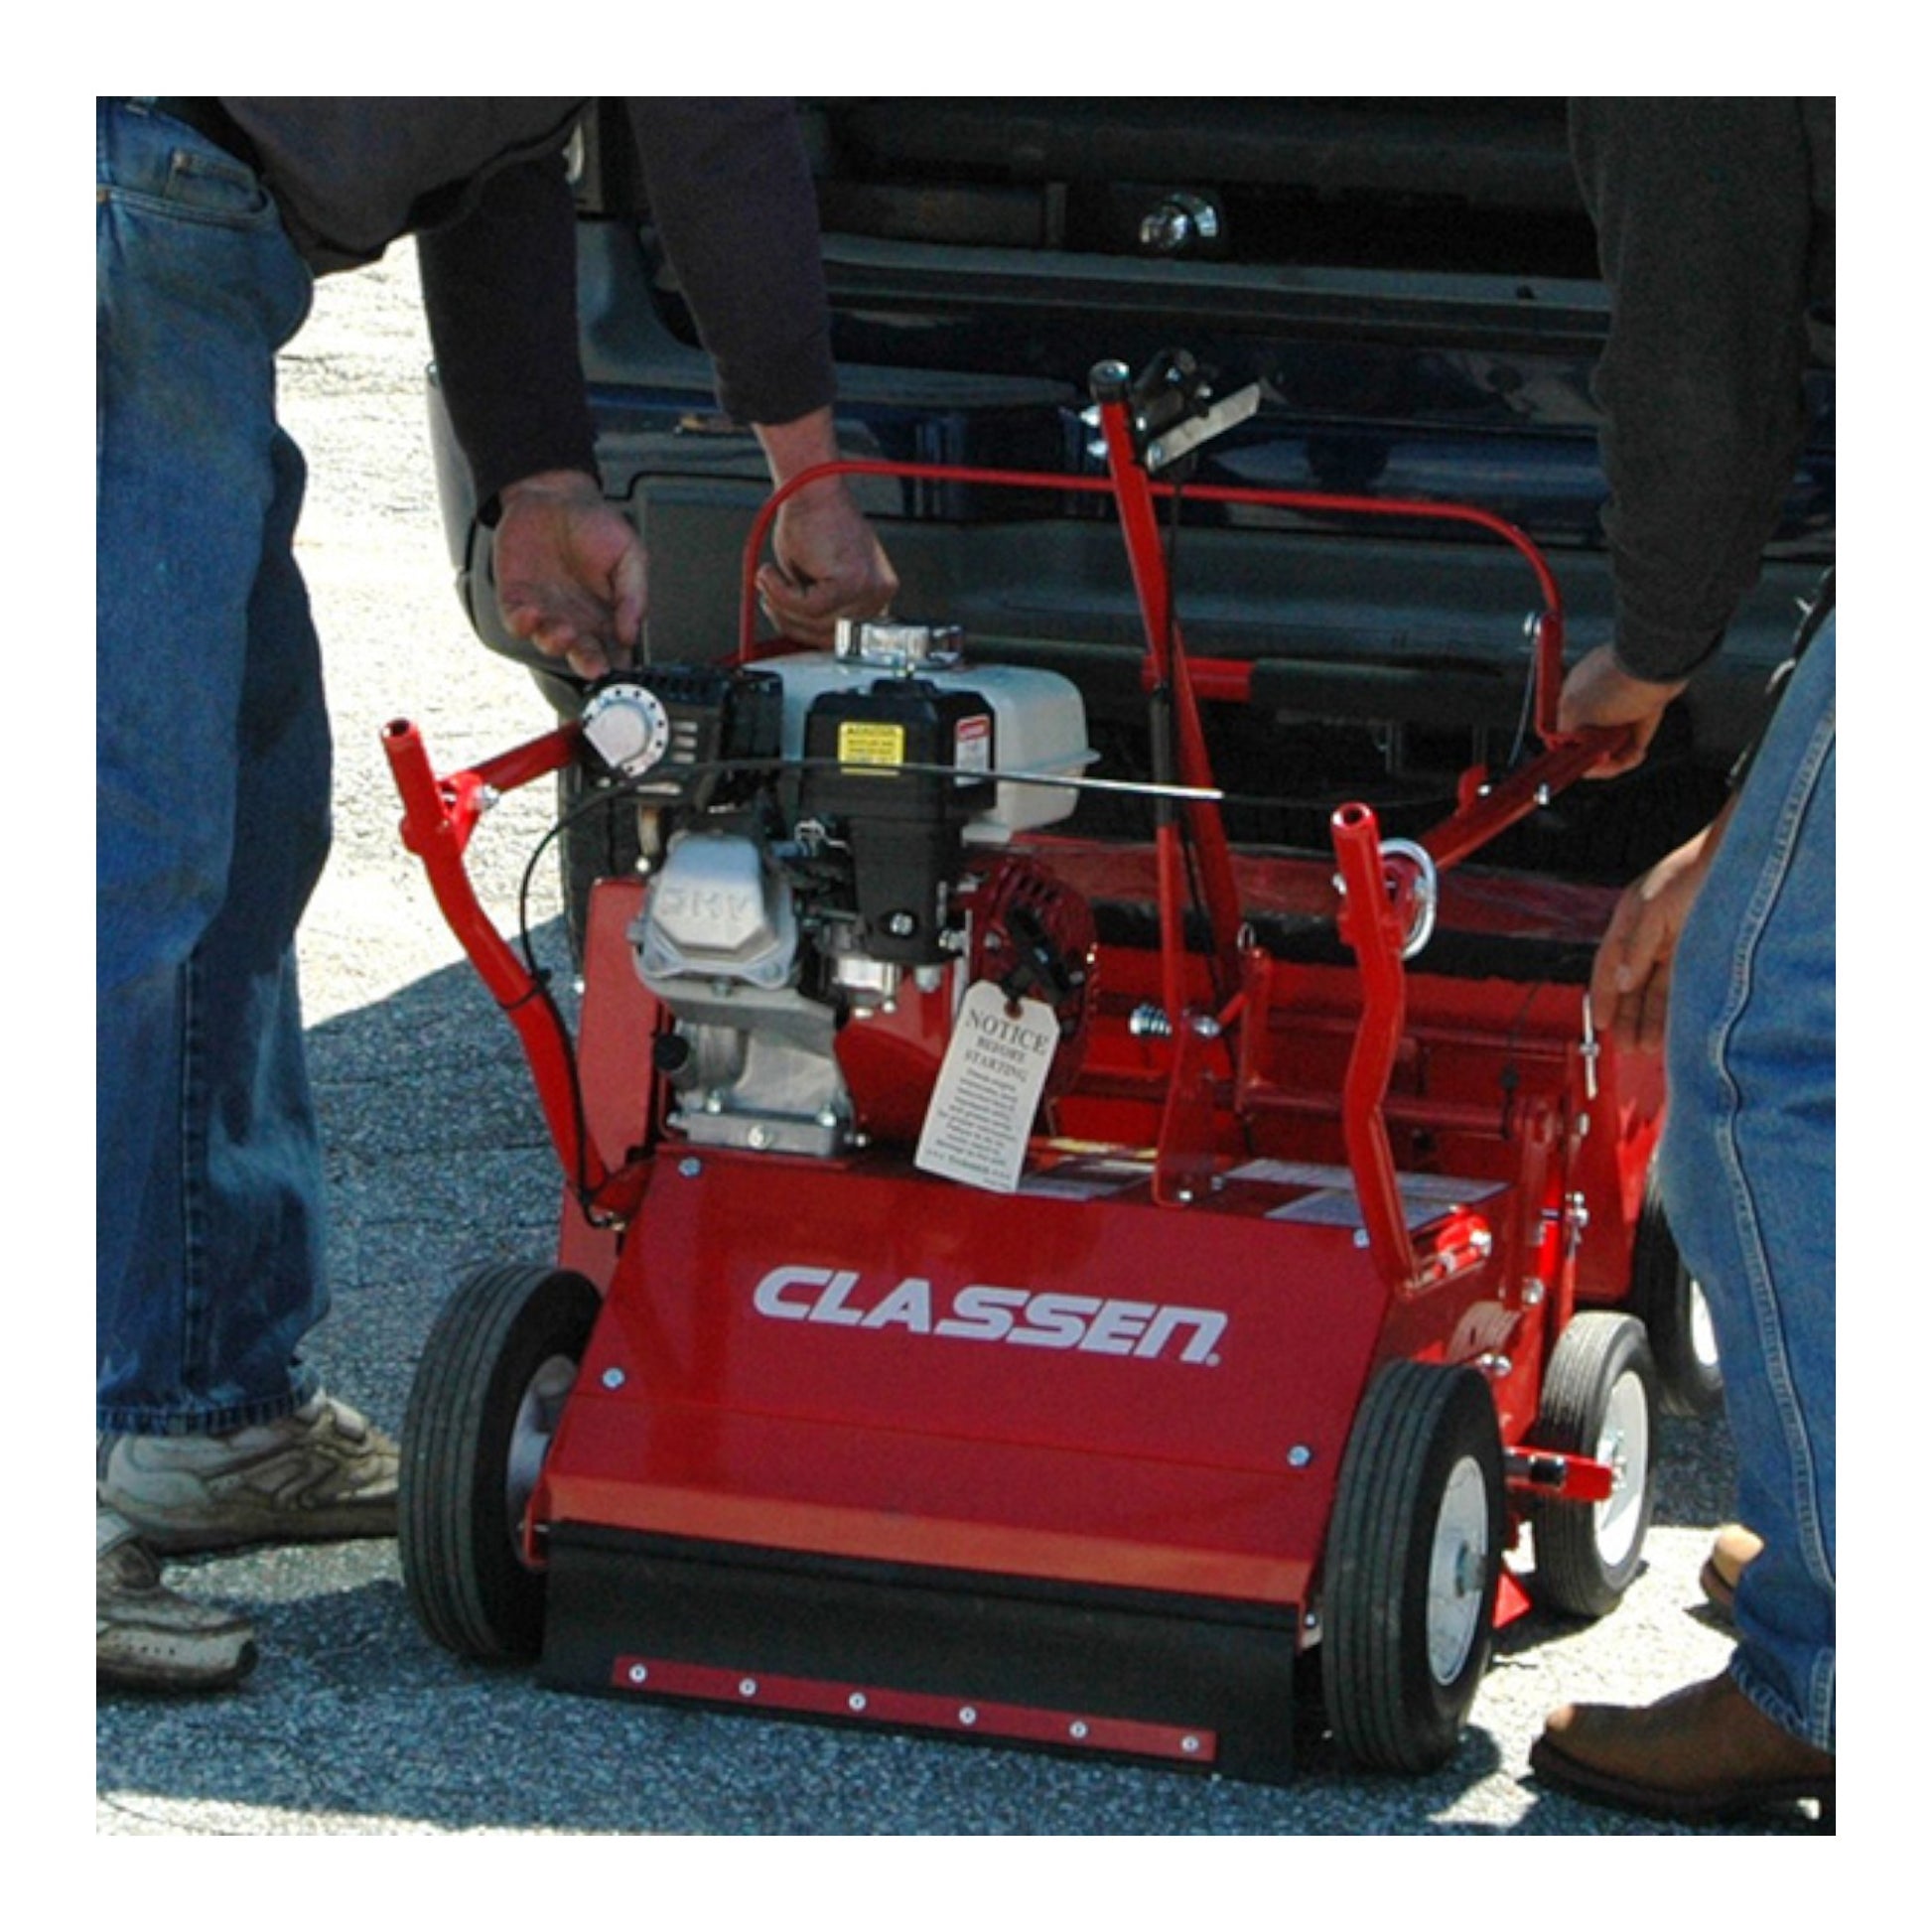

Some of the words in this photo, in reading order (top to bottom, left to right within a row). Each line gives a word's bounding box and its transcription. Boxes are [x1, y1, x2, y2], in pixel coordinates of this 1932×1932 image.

[965, 1008, 1050, 1054] NOTICE
[964, 1049, 1028, 1083] STARTING
[753, 1265, 1228, 1365] CLASSEN
